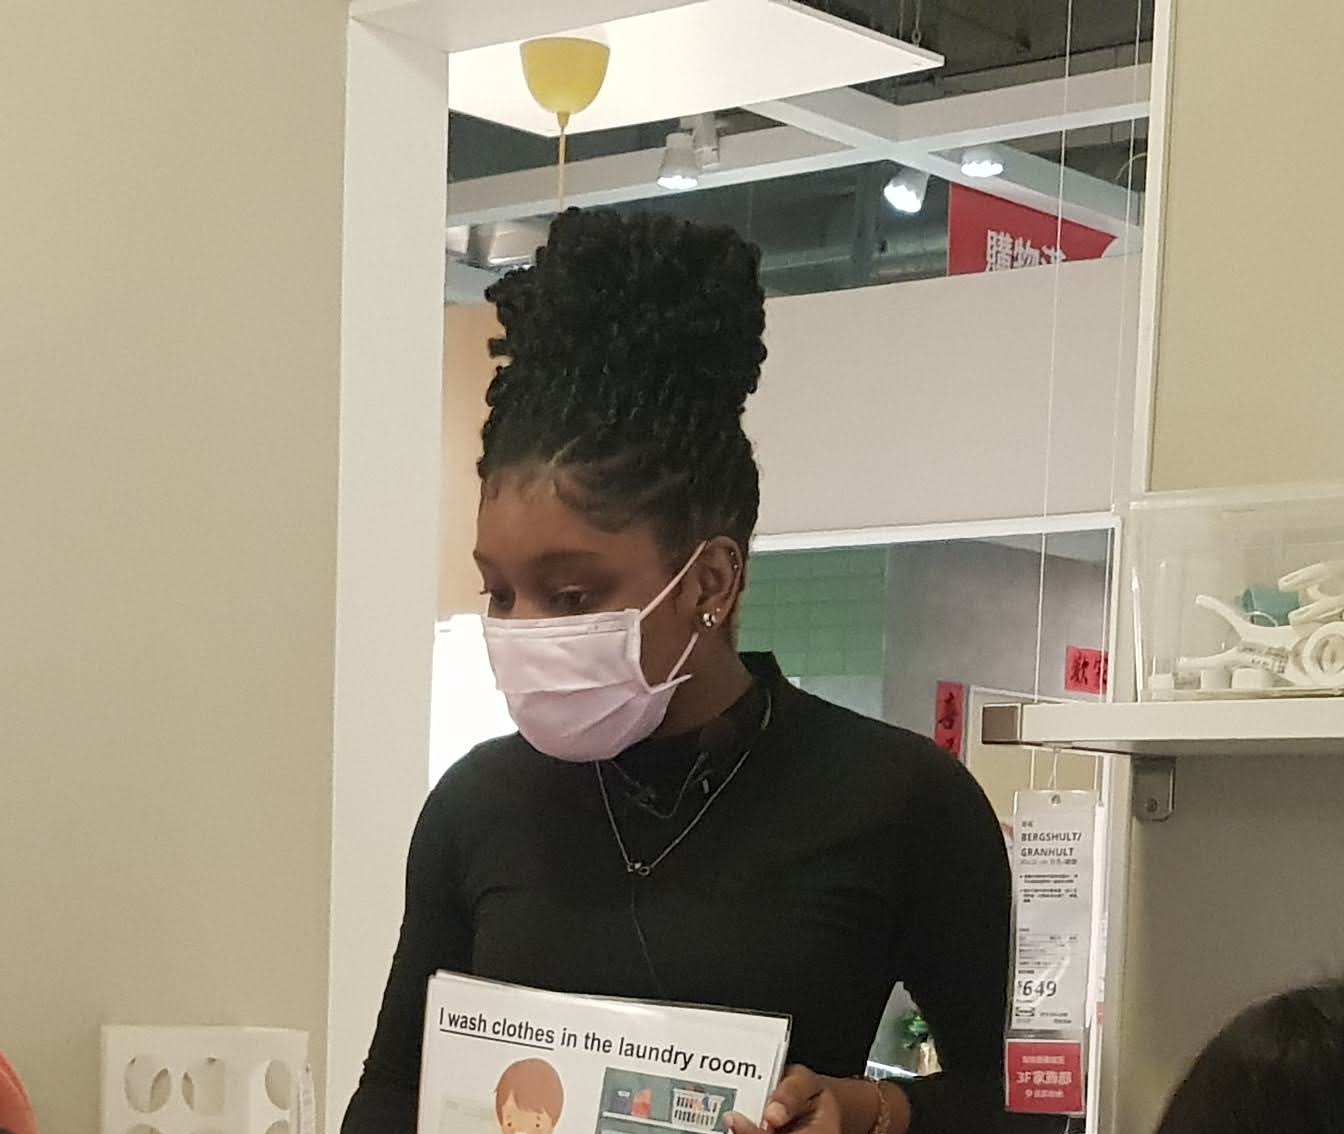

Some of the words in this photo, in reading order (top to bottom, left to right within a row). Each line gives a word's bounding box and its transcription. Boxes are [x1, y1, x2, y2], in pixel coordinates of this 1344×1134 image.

[1020, 832, 1082, 842] BERGSHULT/
[1020, 847, 1074, 857] GRANHULT
[438, 1006, 445, 1026] I
[447, 1012, 488, 1034] wash
[491, 1018, 555, 1045] clothes
[560, 1027, 578, 1049] in
[583, 1031, 614, 1055] the
[618, 1036, 694, 1072] laundry
[698, 1054, 763, 1081] room.
